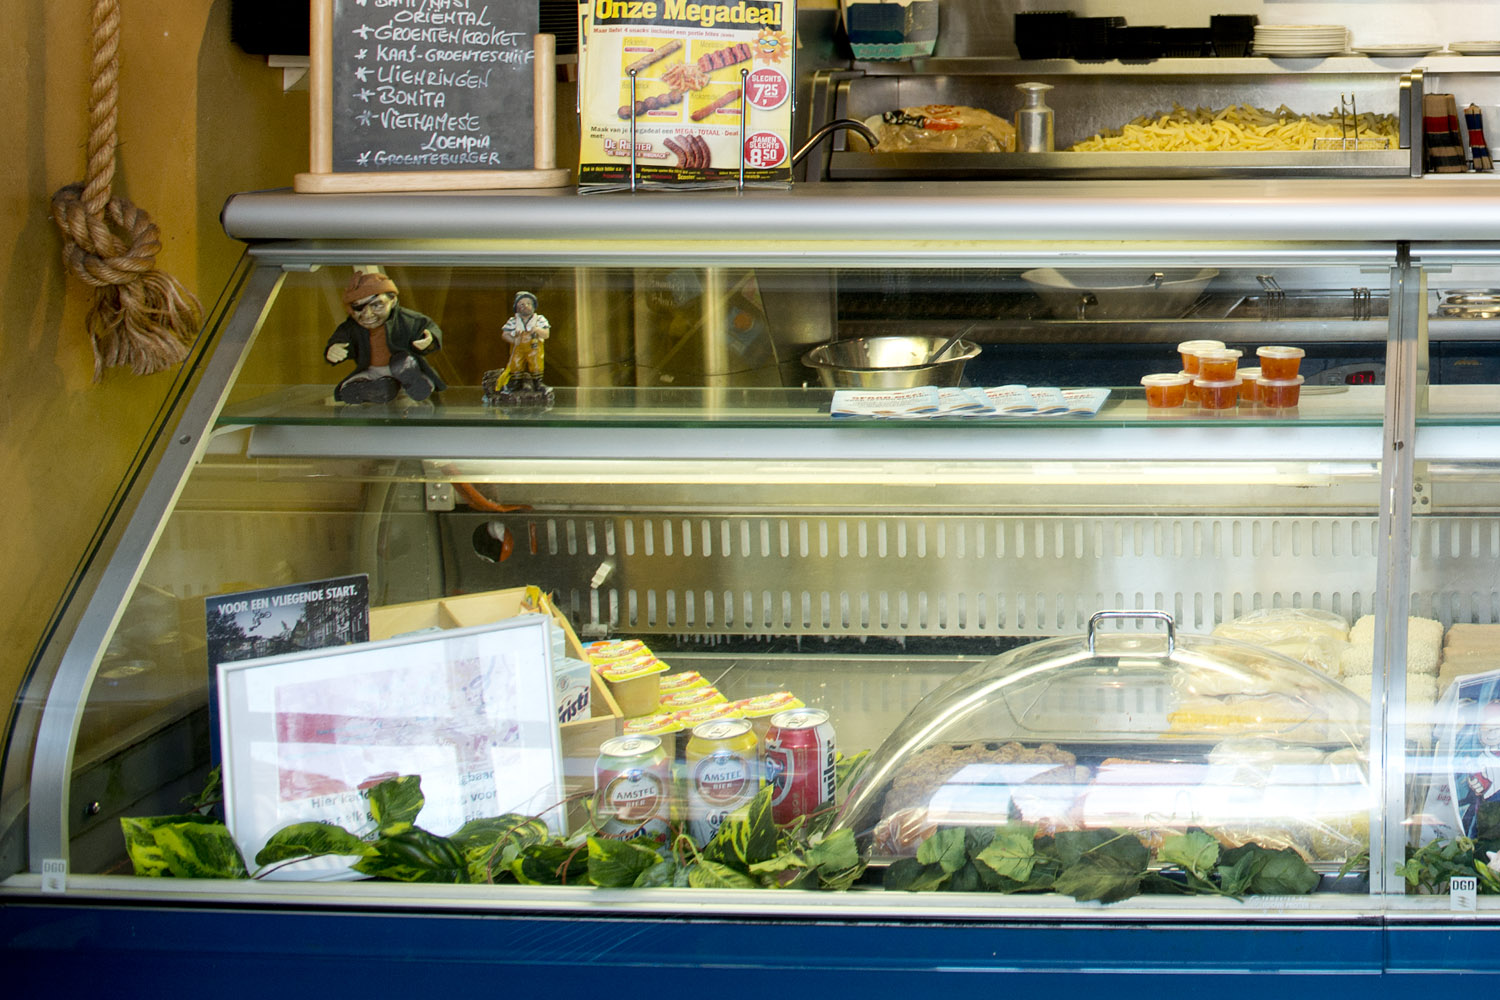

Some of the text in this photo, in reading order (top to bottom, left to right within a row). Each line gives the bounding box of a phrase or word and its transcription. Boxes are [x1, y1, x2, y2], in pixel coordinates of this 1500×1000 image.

[752, 75, 781, 83] SLECHTS
[219, 585, 357, 615] VOOR EEN VLIEGENDE START.
[704, 770, 742, 782] AMSTEL
[616, 787, 656, 800] AMSTEL
[1452, 880, 1474, 890] DGD
